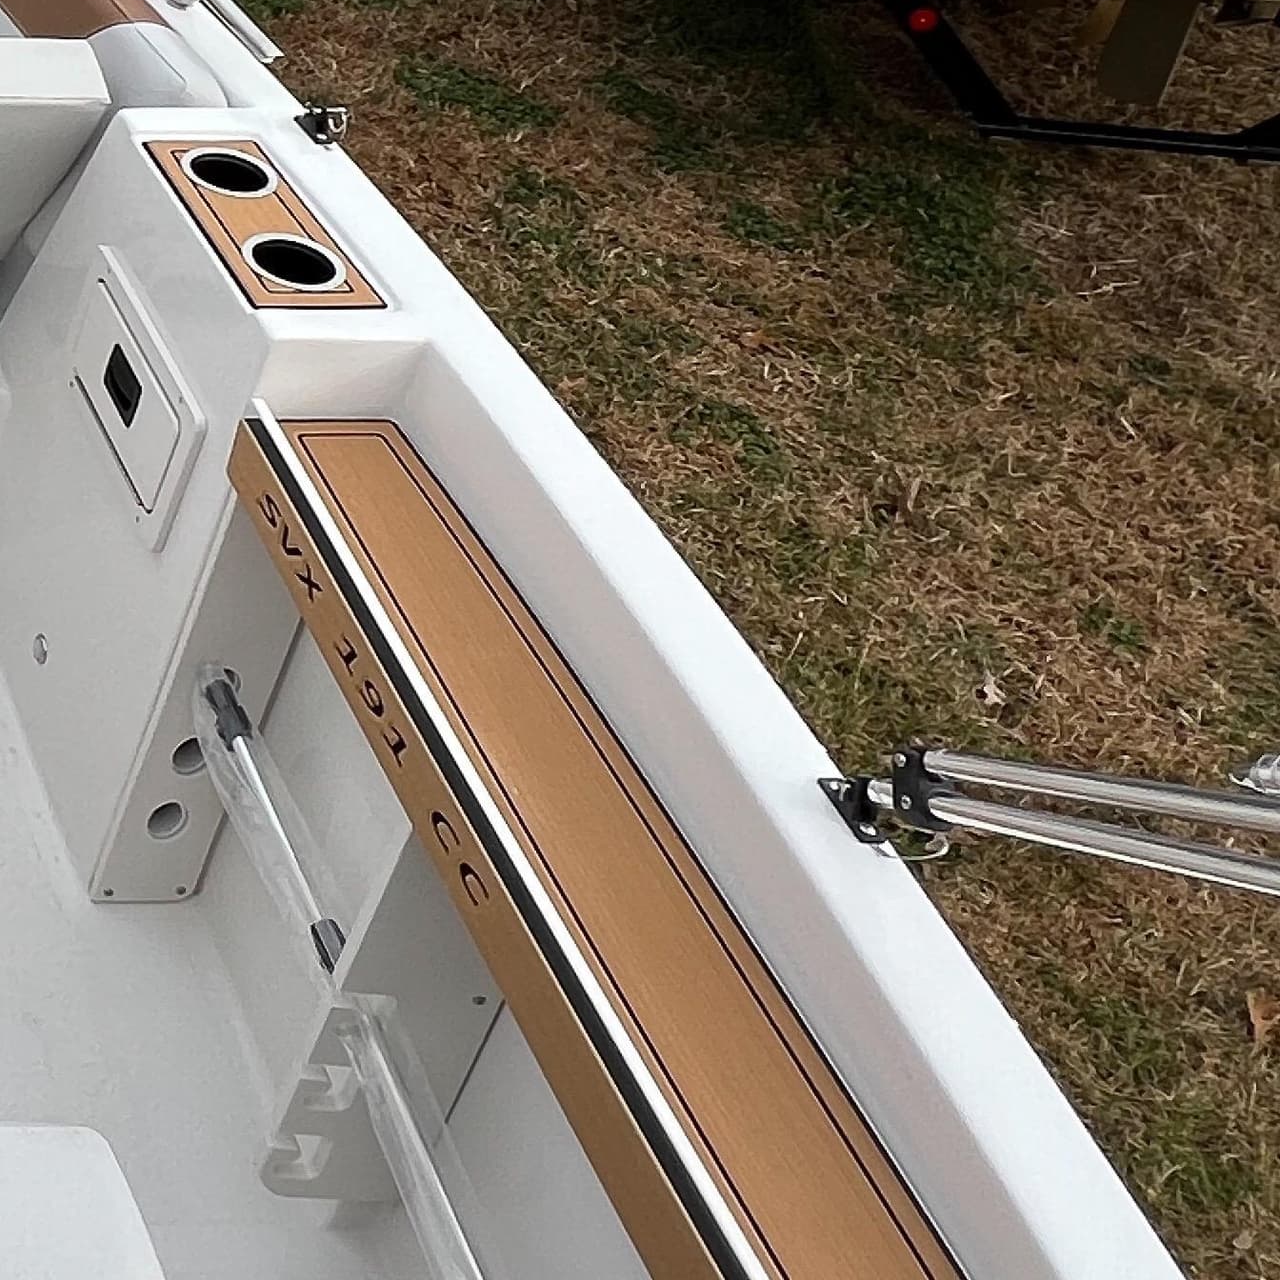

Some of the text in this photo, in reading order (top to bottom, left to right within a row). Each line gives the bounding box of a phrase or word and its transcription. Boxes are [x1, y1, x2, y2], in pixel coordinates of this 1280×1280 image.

[259, 492, 489, 907] SVX 191 CC
